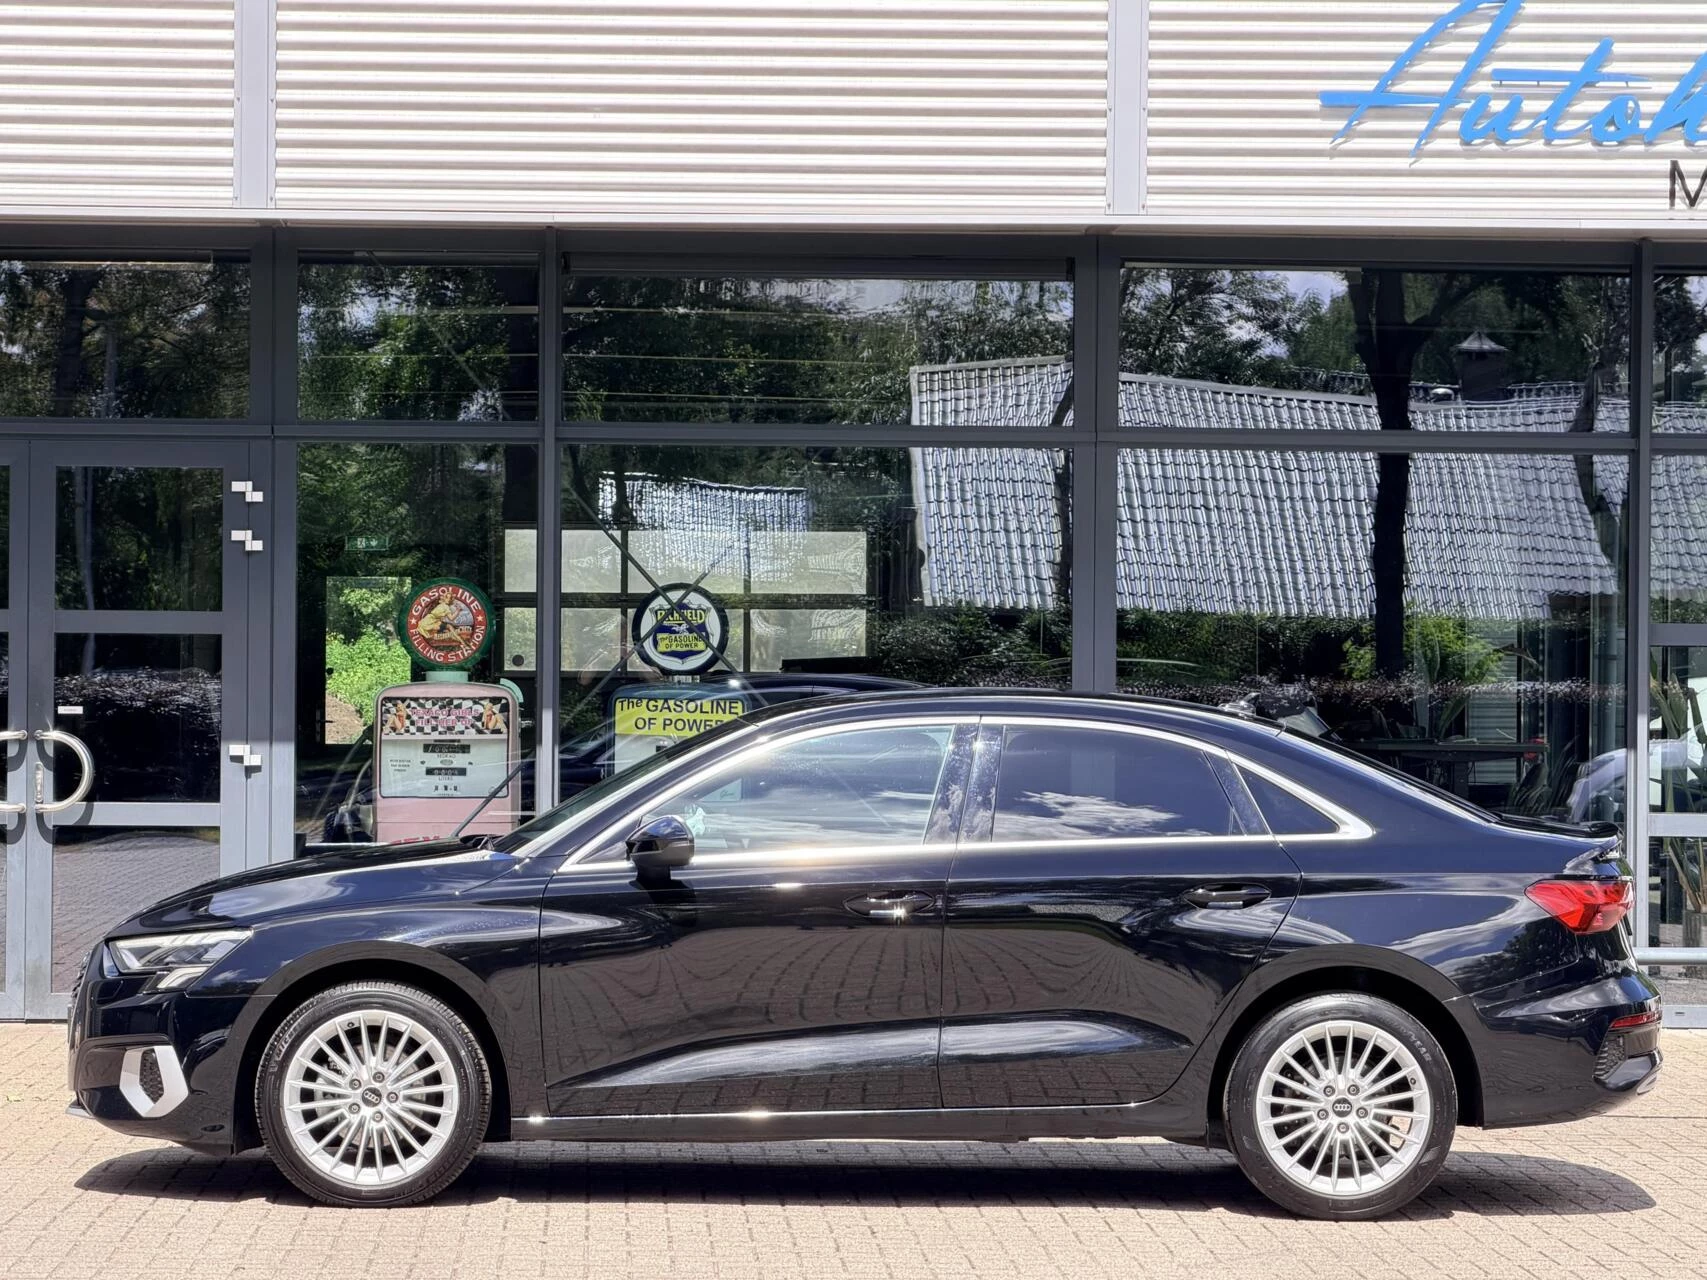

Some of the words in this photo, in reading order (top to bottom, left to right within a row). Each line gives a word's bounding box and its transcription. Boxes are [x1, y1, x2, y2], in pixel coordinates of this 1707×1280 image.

[412, 587, 481, 615] GASOLINE
[657, 609, 705, 623] RCHIELD
[410, 628, 445, 662] FILLING
[447, 625, 485, 662] STATION
[619, 699, 643, 711] The
[645, 699, 740, 715] GASOLINE
[634, 717, 657, 730] OF
